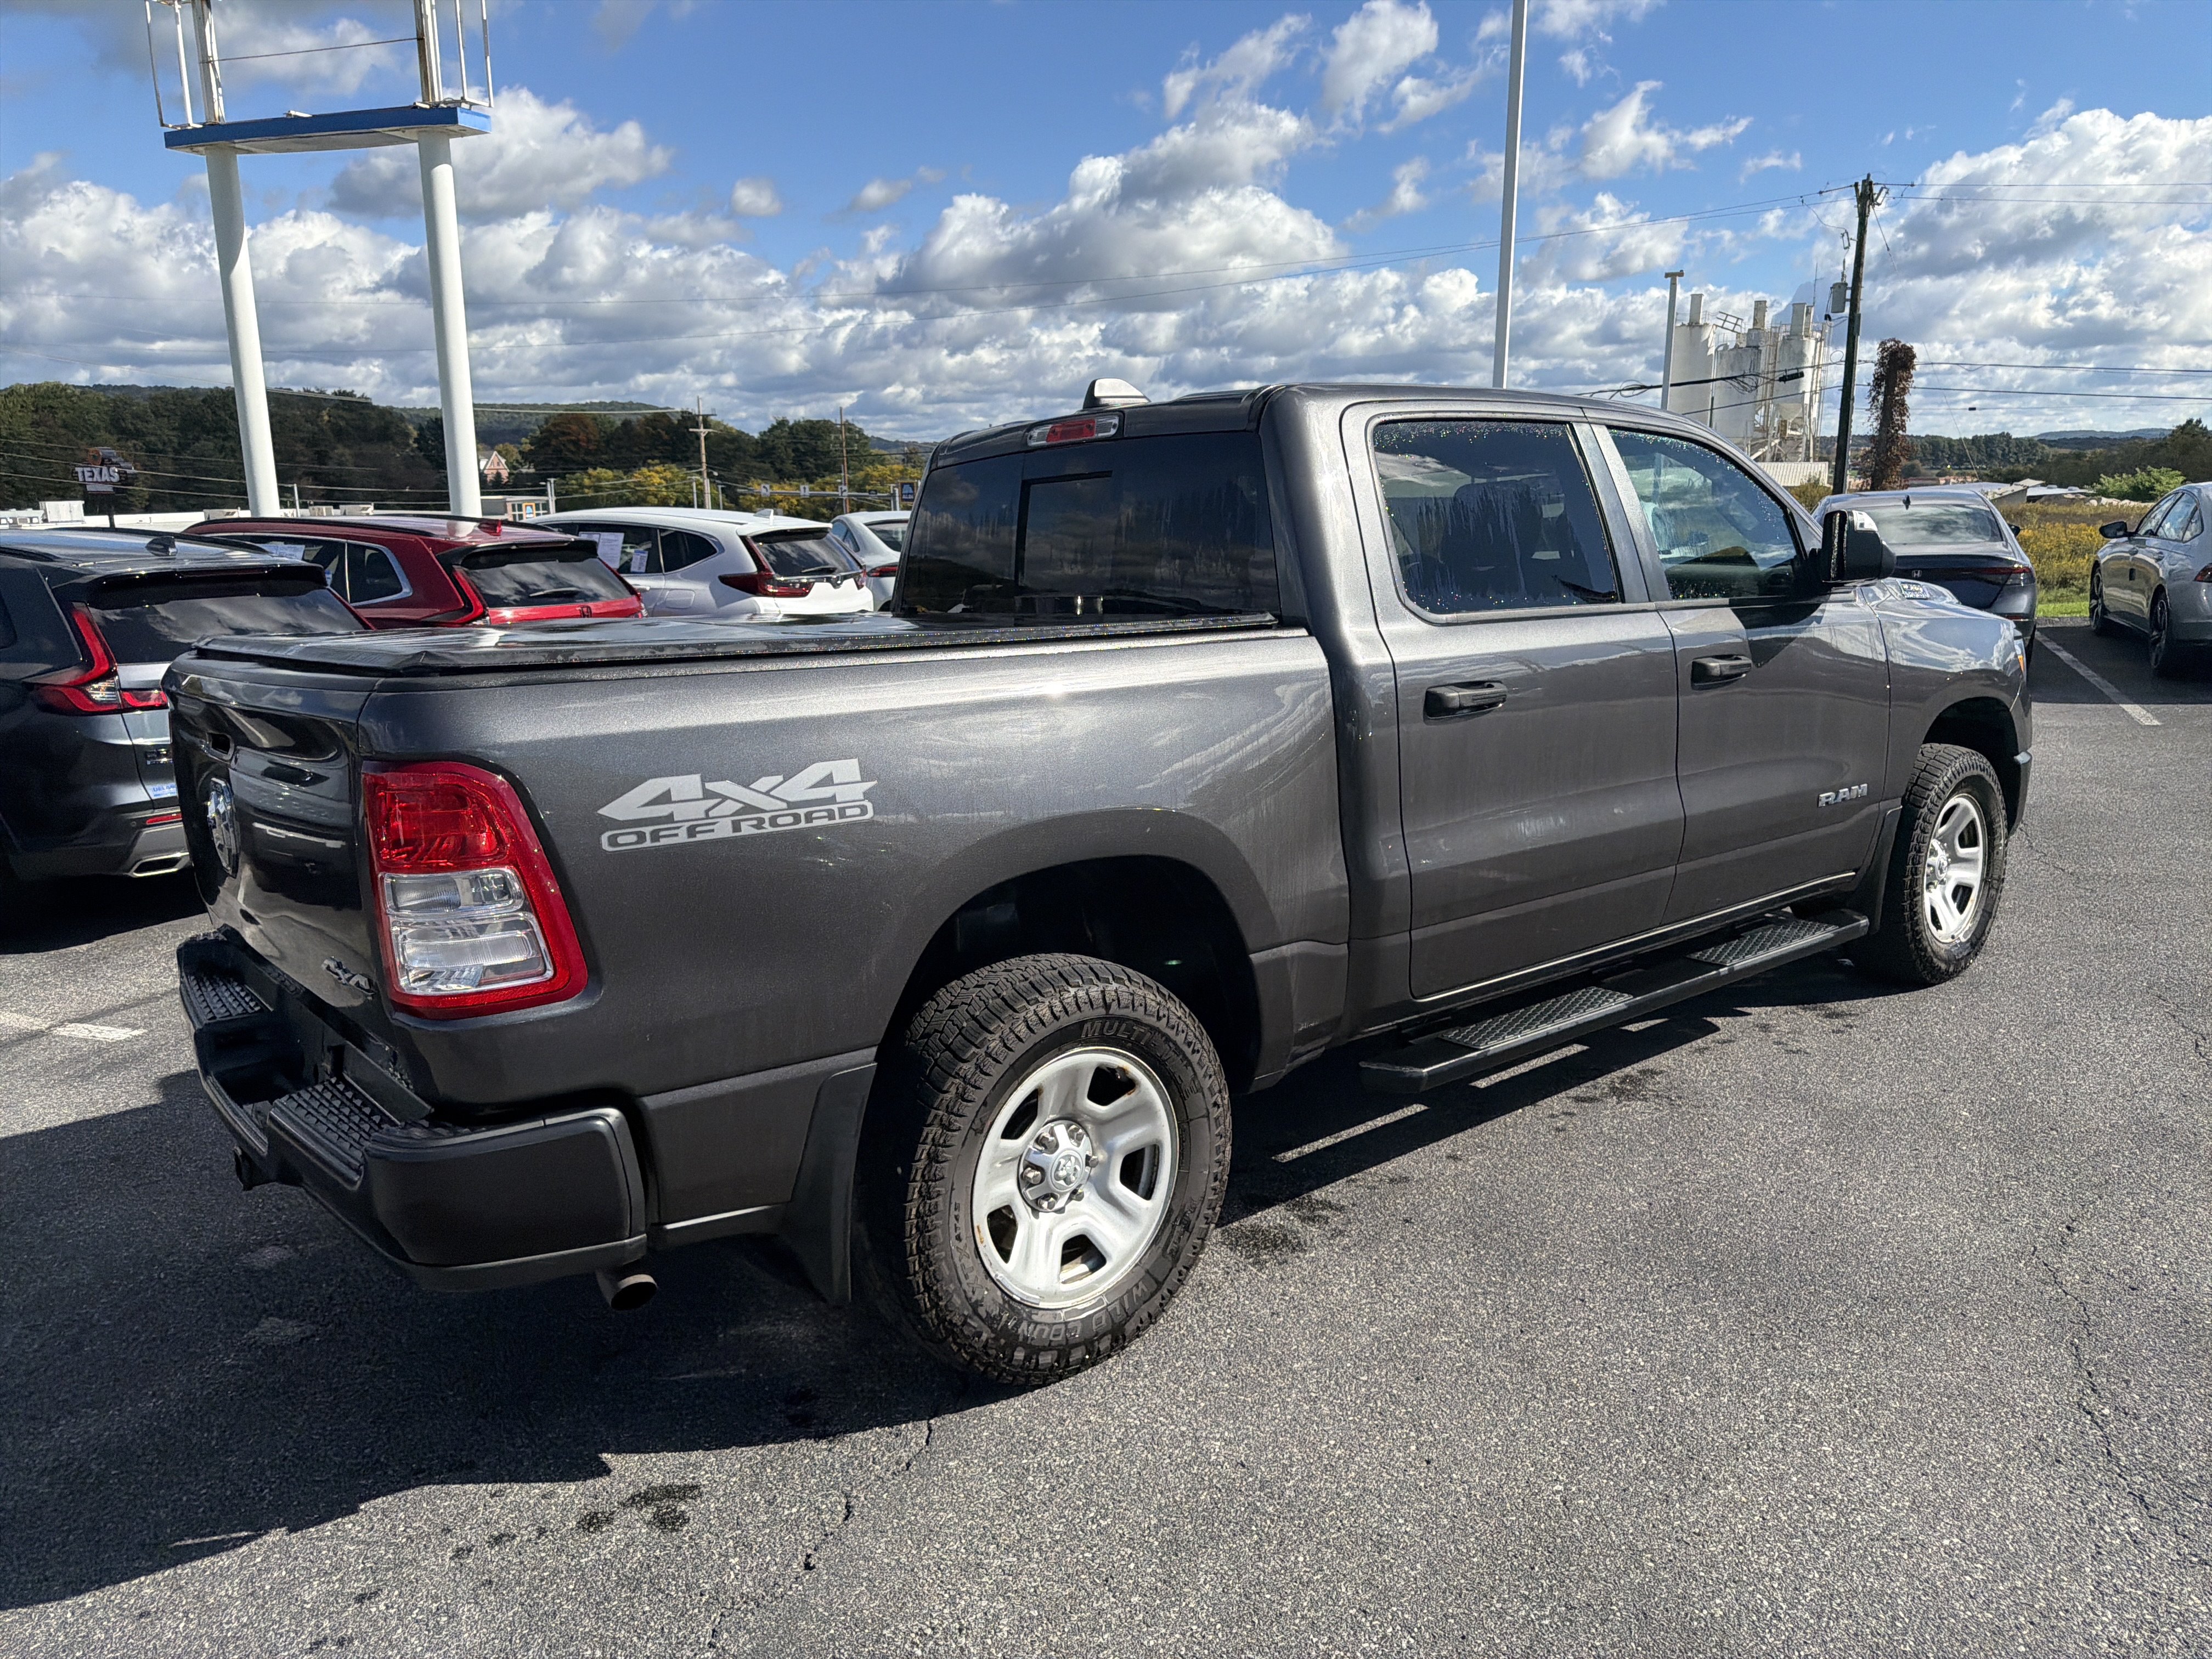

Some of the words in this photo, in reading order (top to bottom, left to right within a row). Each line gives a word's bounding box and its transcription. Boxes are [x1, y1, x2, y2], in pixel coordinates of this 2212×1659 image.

[75, 466, 120, 482] TEXAS
[1817, 783, 1868, 808] RAM
[606, 820, 722, 848] OFF
[730, 802, 870, 834] ROAD
